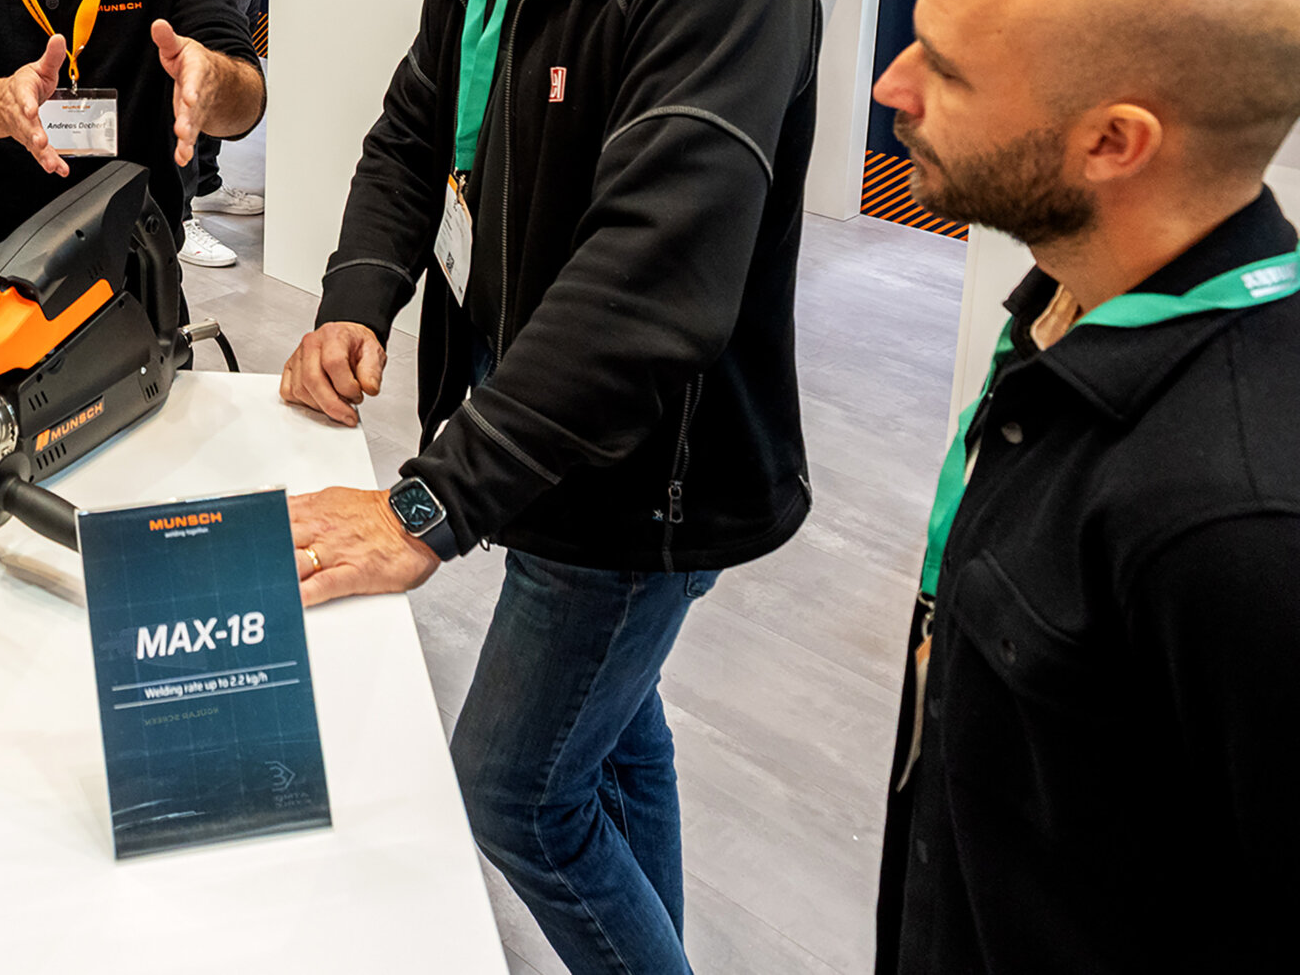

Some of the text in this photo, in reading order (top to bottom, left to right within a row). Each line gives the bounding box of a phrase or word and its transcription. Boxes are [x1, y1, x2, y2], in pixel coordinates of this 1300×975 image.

[50, 402, 104, 442] MUNSCH
[149, 511, 223, 532] MUNSCH
[136, 611, 266, 660] MAX-18
[144, 671, 268, 699] Welding rate up to 2.2 kg/h
